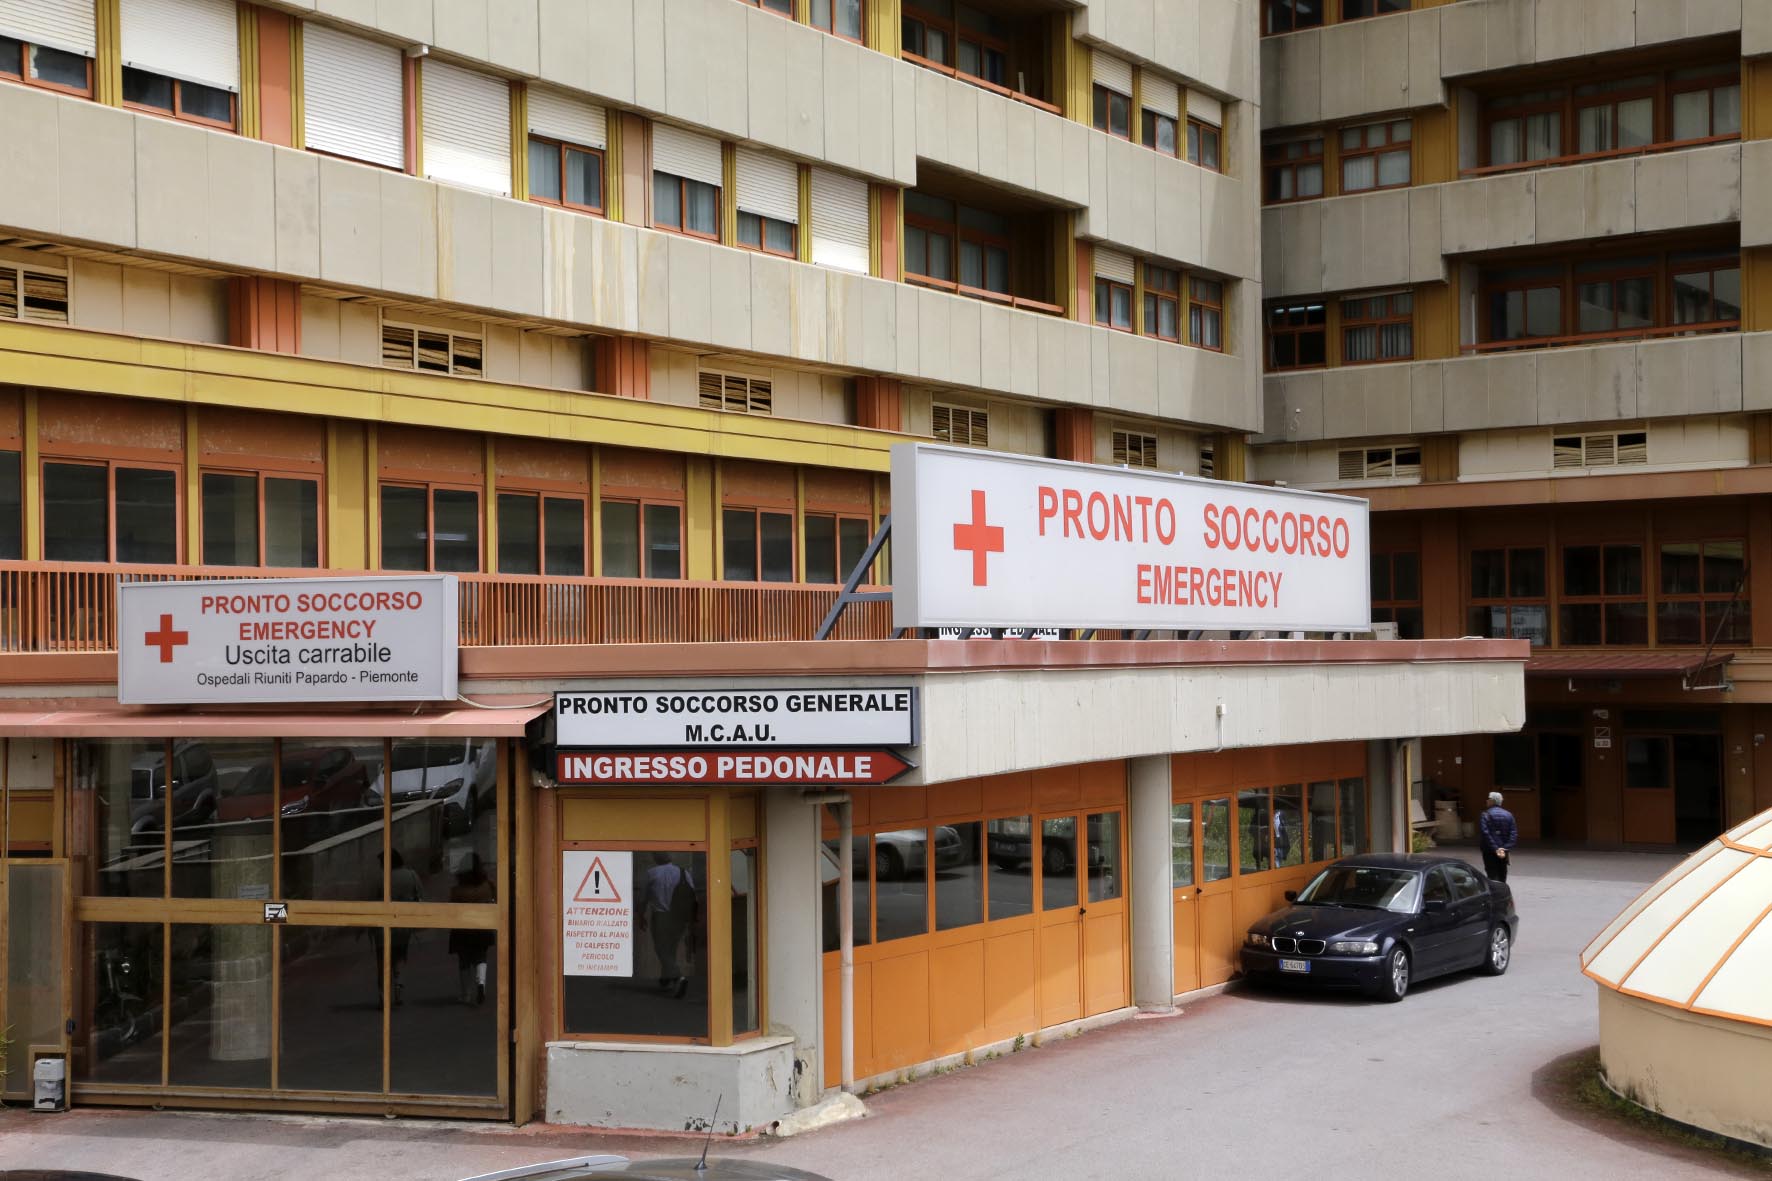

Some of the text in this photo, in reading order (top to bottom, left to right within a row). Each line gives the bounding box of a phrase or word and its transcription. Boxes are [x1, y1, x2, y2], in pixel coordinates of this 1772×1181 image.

[1038, 485, 1350, 559] PRONTO SOCCORSO
[1136, 564, 1283, 608] EMERGENCY
[201, 591, 423, 614] PRONTO SOCCORSO
[239, 620, 377, 641] EMERGENCY
[225, 642, 392, 665] Uscita carrabile
[196, 671, 250, 688] Ospedali
[254, 670, 292, 685] Riuniti
[295, 671, 348, 686] Papardo
[360, 670, 419, 684] Piemonte
[559, 694, 909, 714] PRONTO SOCCORSO GENERALE
[685, 724, 776, 742] M.C.A.U.
[564, 756, 872, 779] INGRESSO PEDONALE
[566, 907, 630, 916] ATTENZIONE
[566, 930, 598, 938] RISPETTO
[609, 931, 630, 939] PIANO
[584, 942, 621, 950] CALPESTIO
[581, 953, 615, 961] PERICOLO
